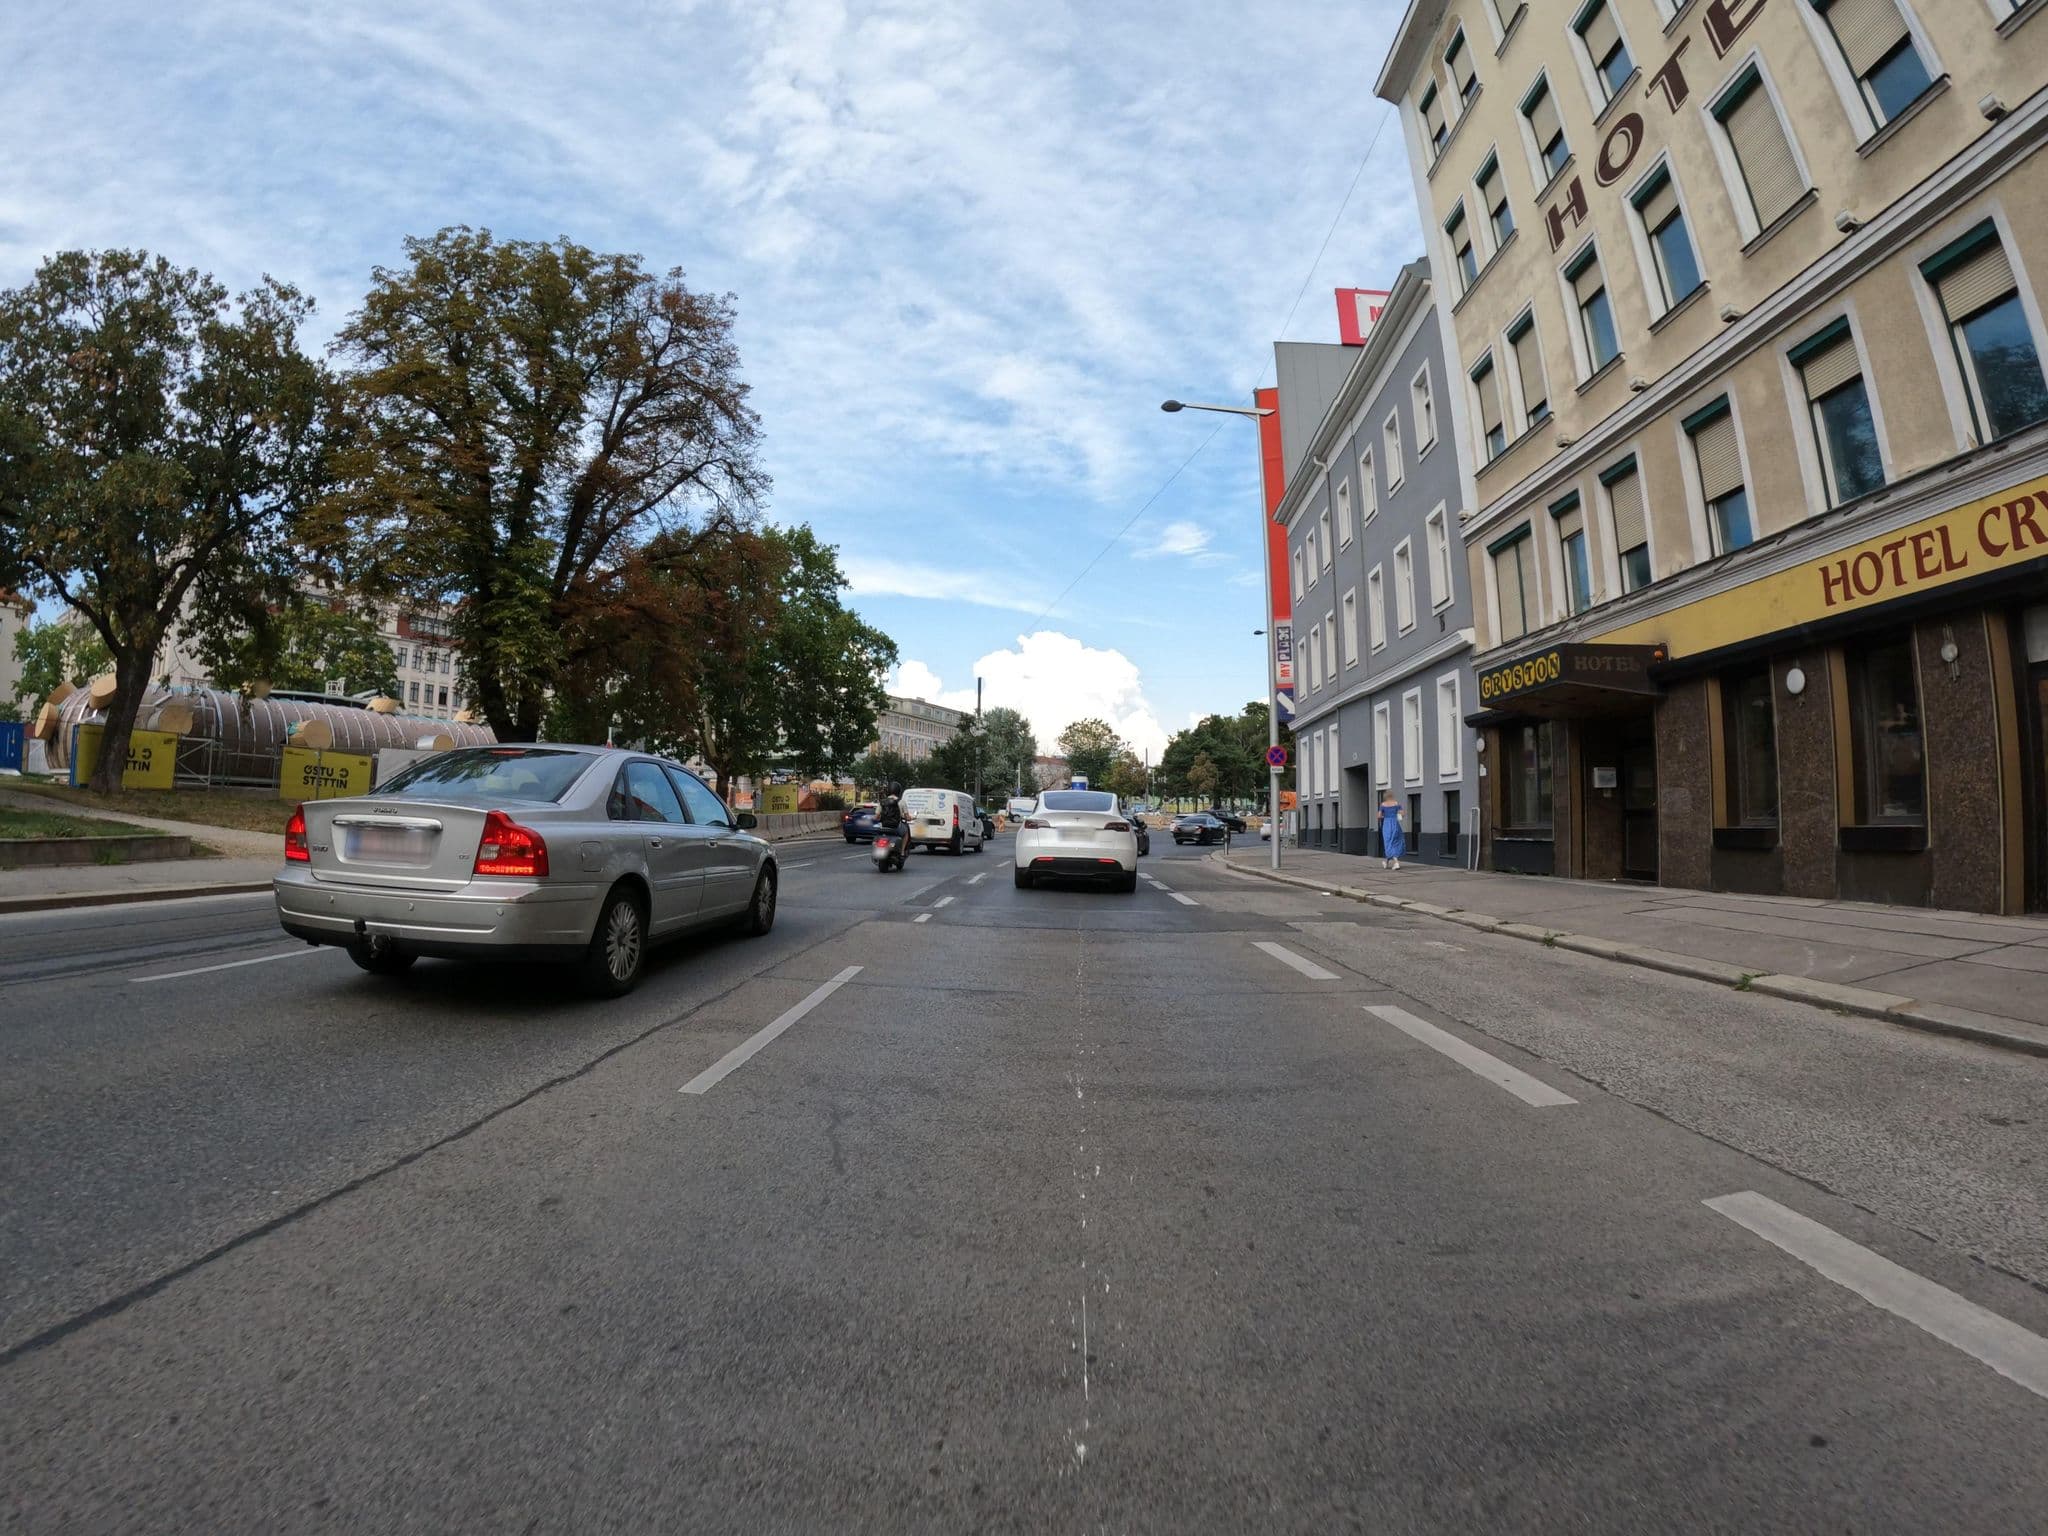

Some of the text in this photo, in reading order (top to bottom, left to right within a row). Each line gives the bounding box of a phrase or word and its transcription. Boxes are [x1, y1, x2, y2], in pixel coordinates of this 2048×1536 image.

[1819, 490, 2048, 607] HOTEL CR
[1574, 655, 1641, 673] HOTEL
